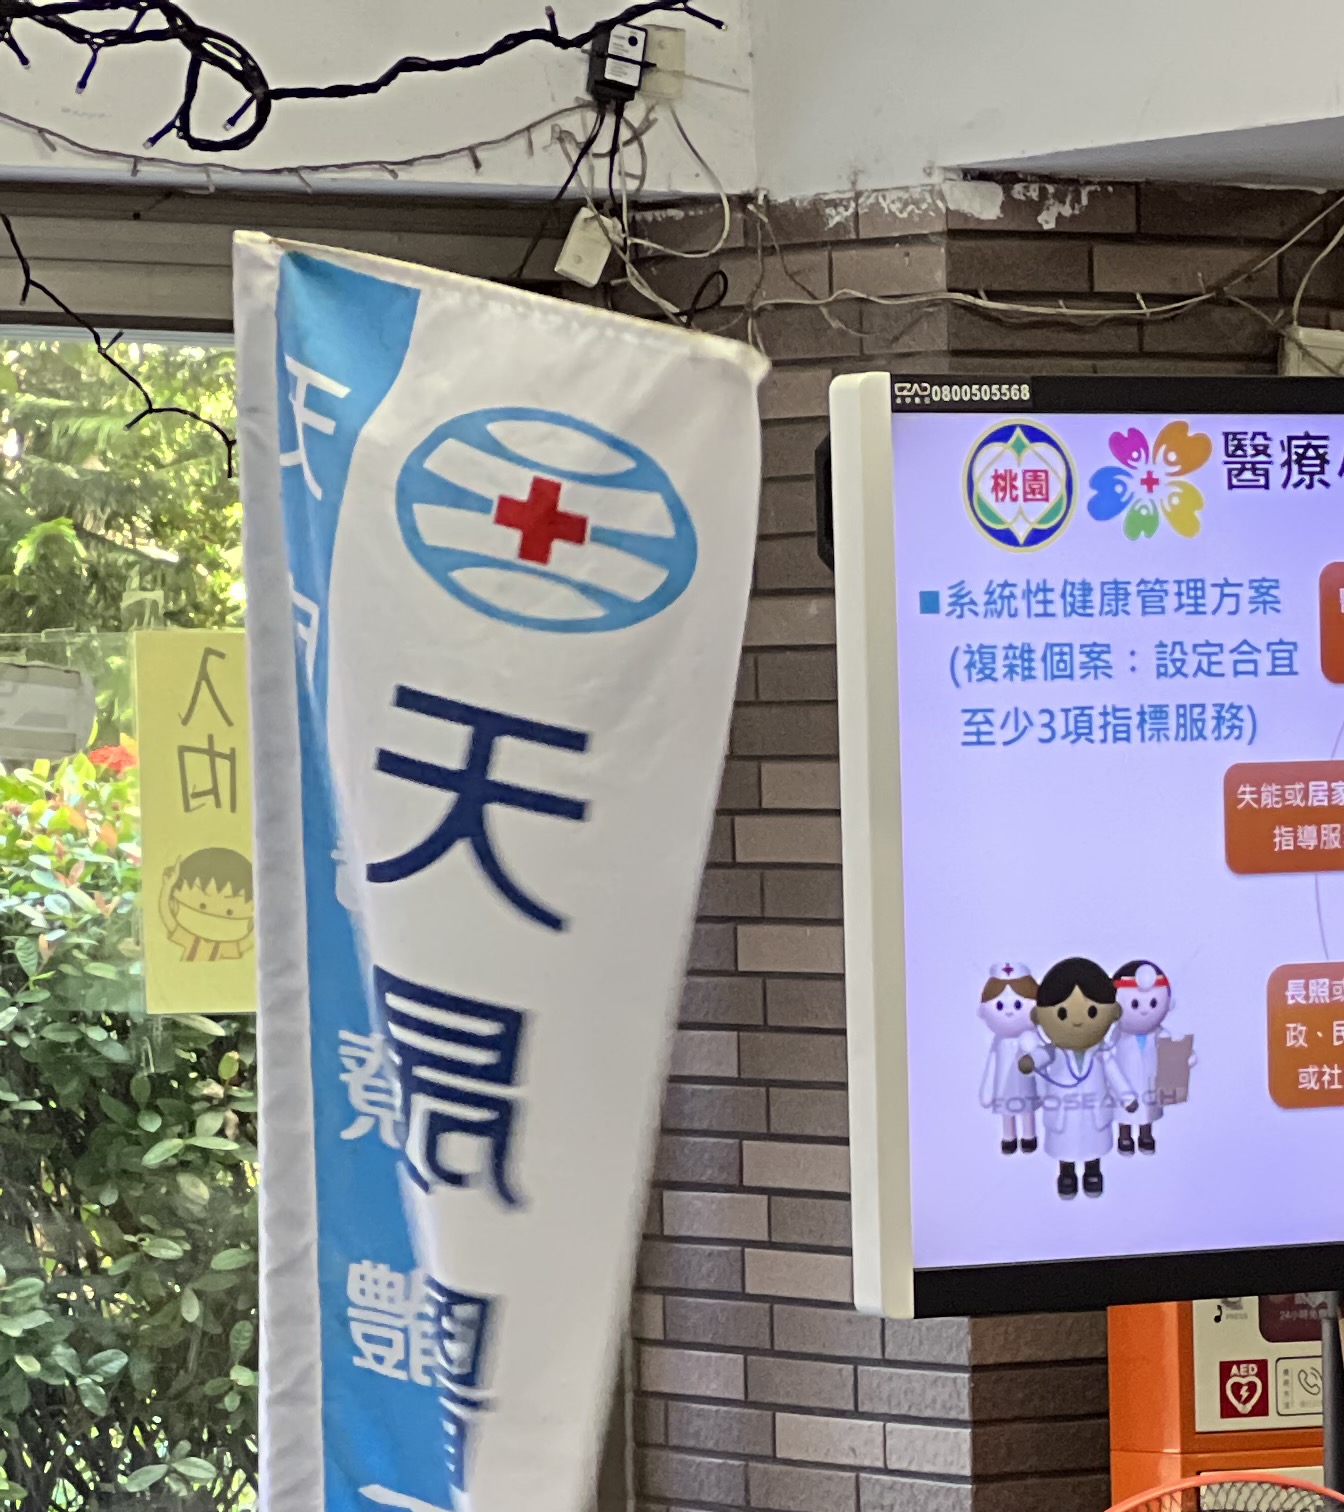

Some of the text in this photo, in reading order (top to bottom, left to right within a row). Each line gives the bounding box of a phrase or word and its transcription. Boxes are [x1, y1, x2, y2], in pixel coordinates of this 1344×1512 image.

[931, 383, 1030, 402] 0800505568
[991, 468, 1049, 503] 桃園
[945, 576, 1282, 620] 系統性健康管理方案
[949, 637, 1300, 686] (複雜個案：設定合宜
[960, 701, 1258, 748] 至少3項指標服務)
[1230, 1363, 1258, 1378] AED
